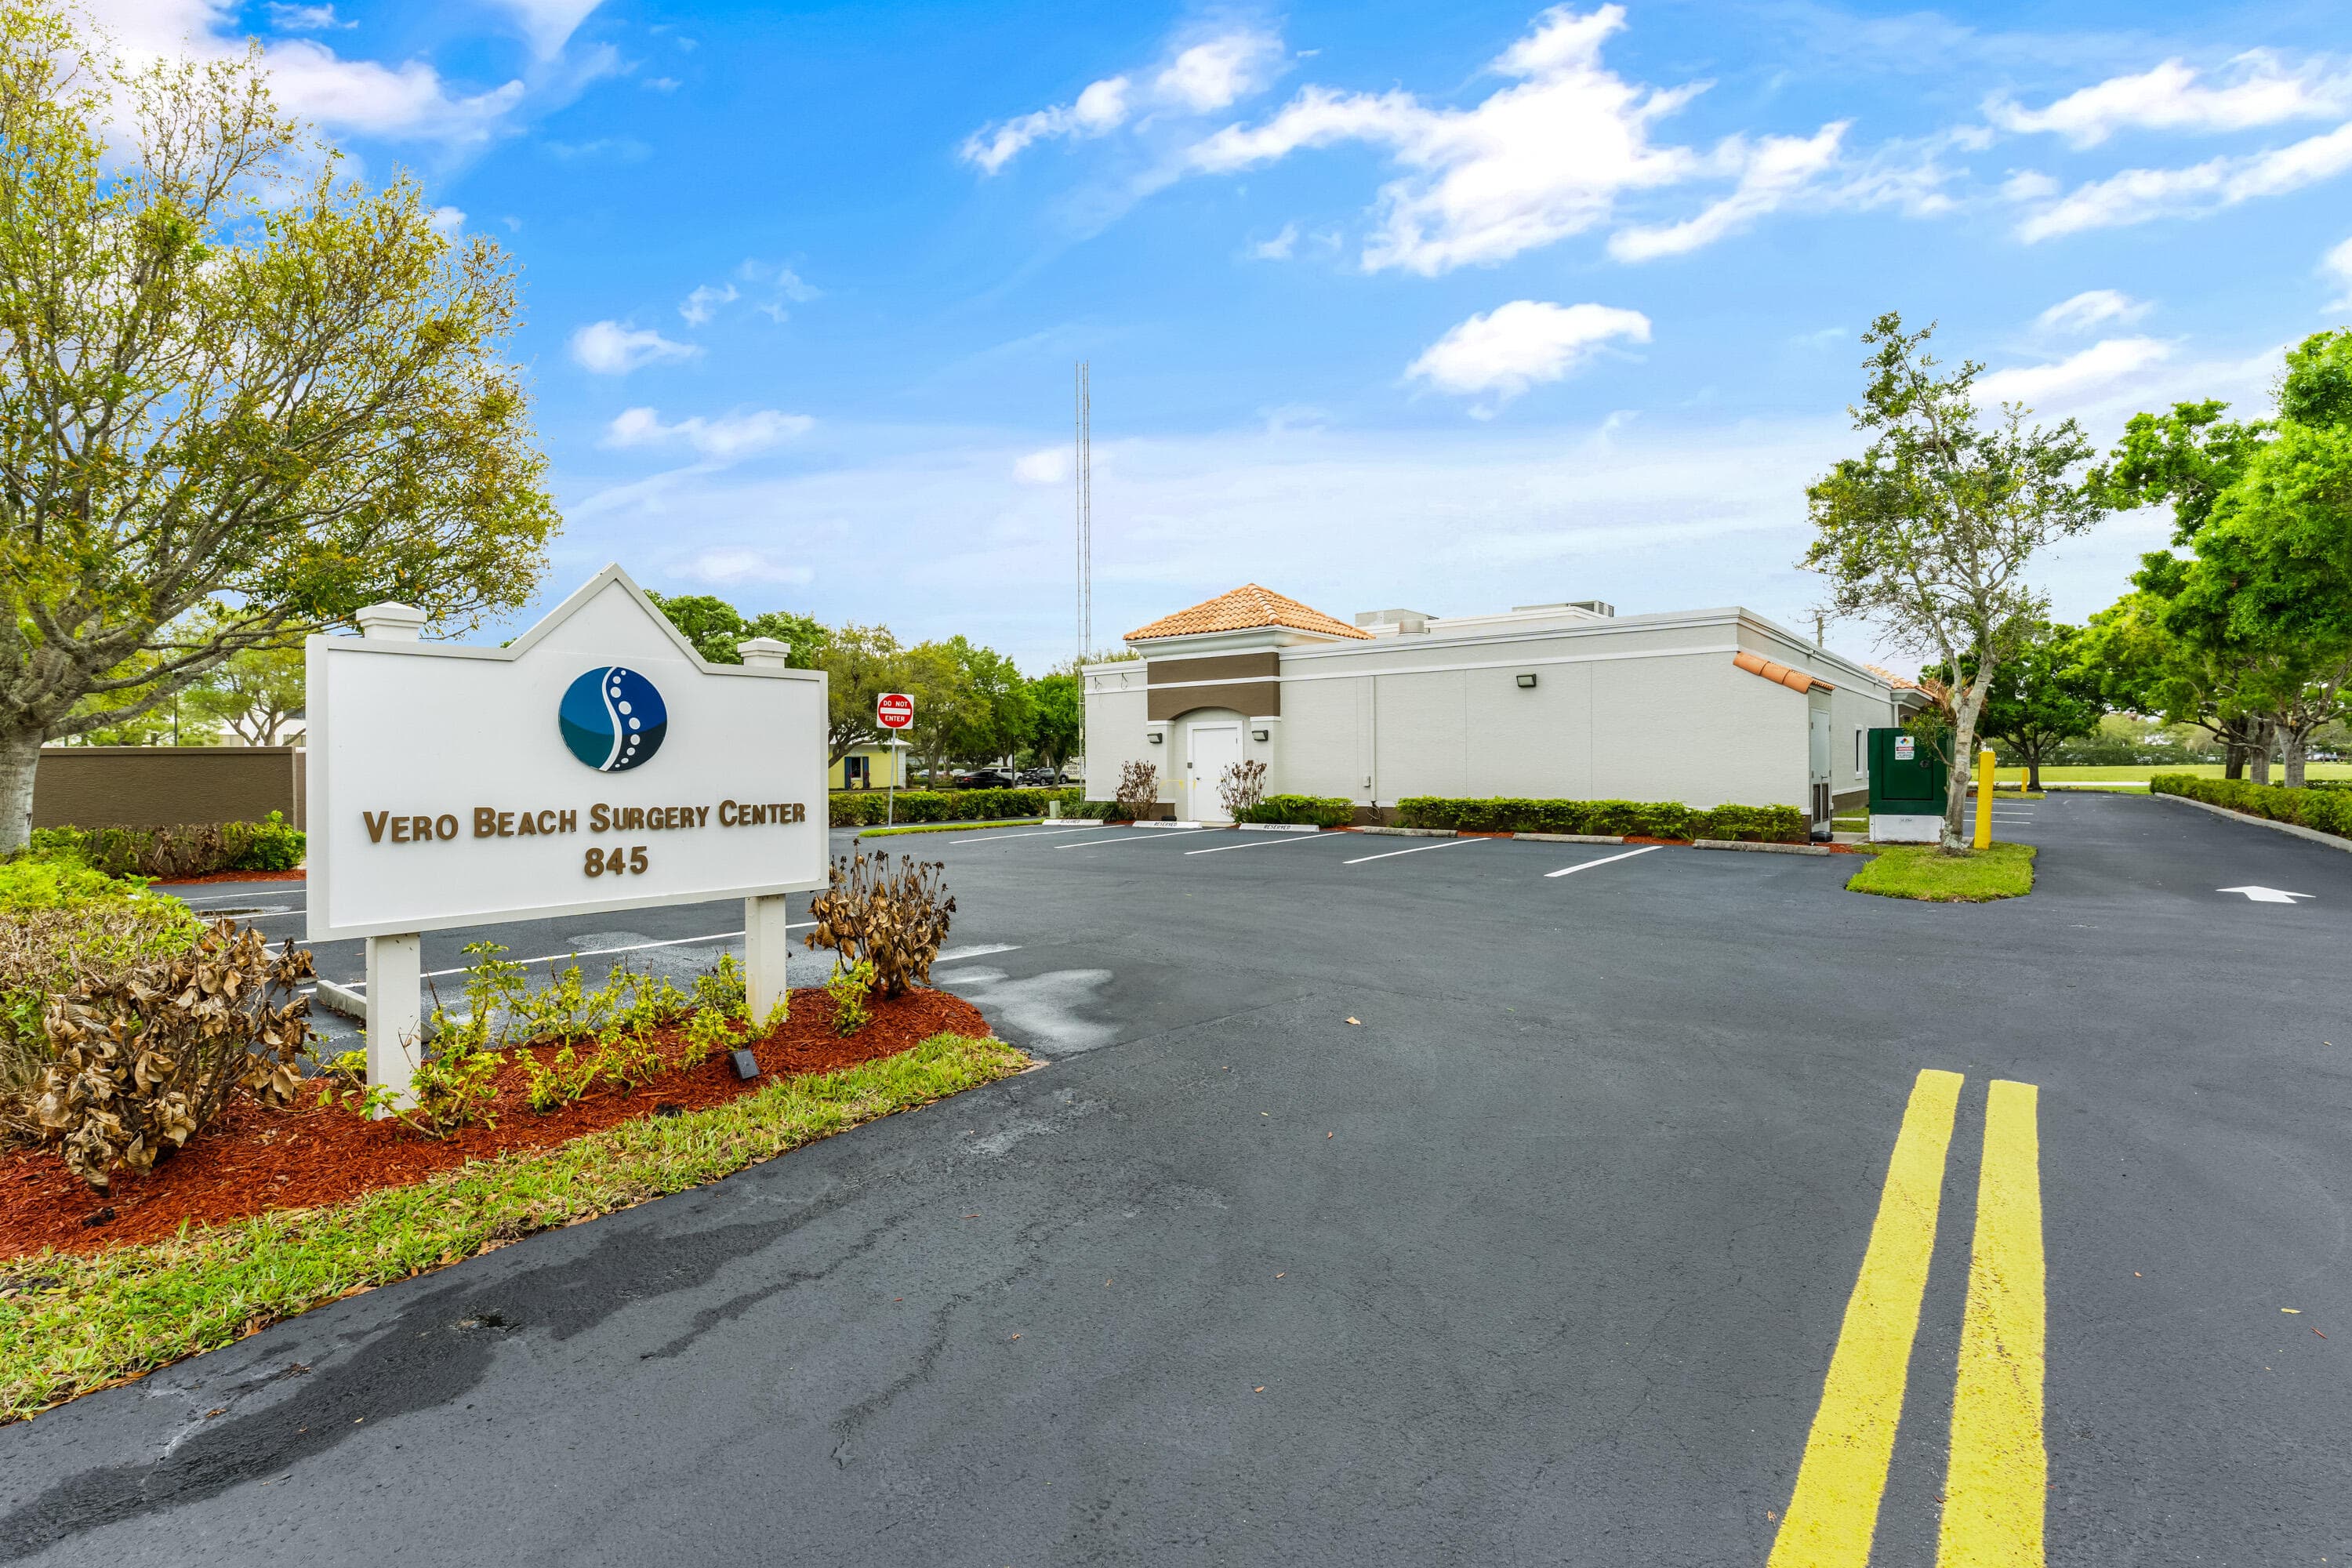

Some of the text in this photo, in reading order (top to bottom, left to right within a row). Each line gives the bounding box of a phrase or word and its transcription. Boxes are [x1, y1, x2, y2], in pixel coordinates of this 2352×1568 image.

[362, 799, 806, 843] VERO BEACH SURGERY CENTER
[584, 845, 649, 877] 845
